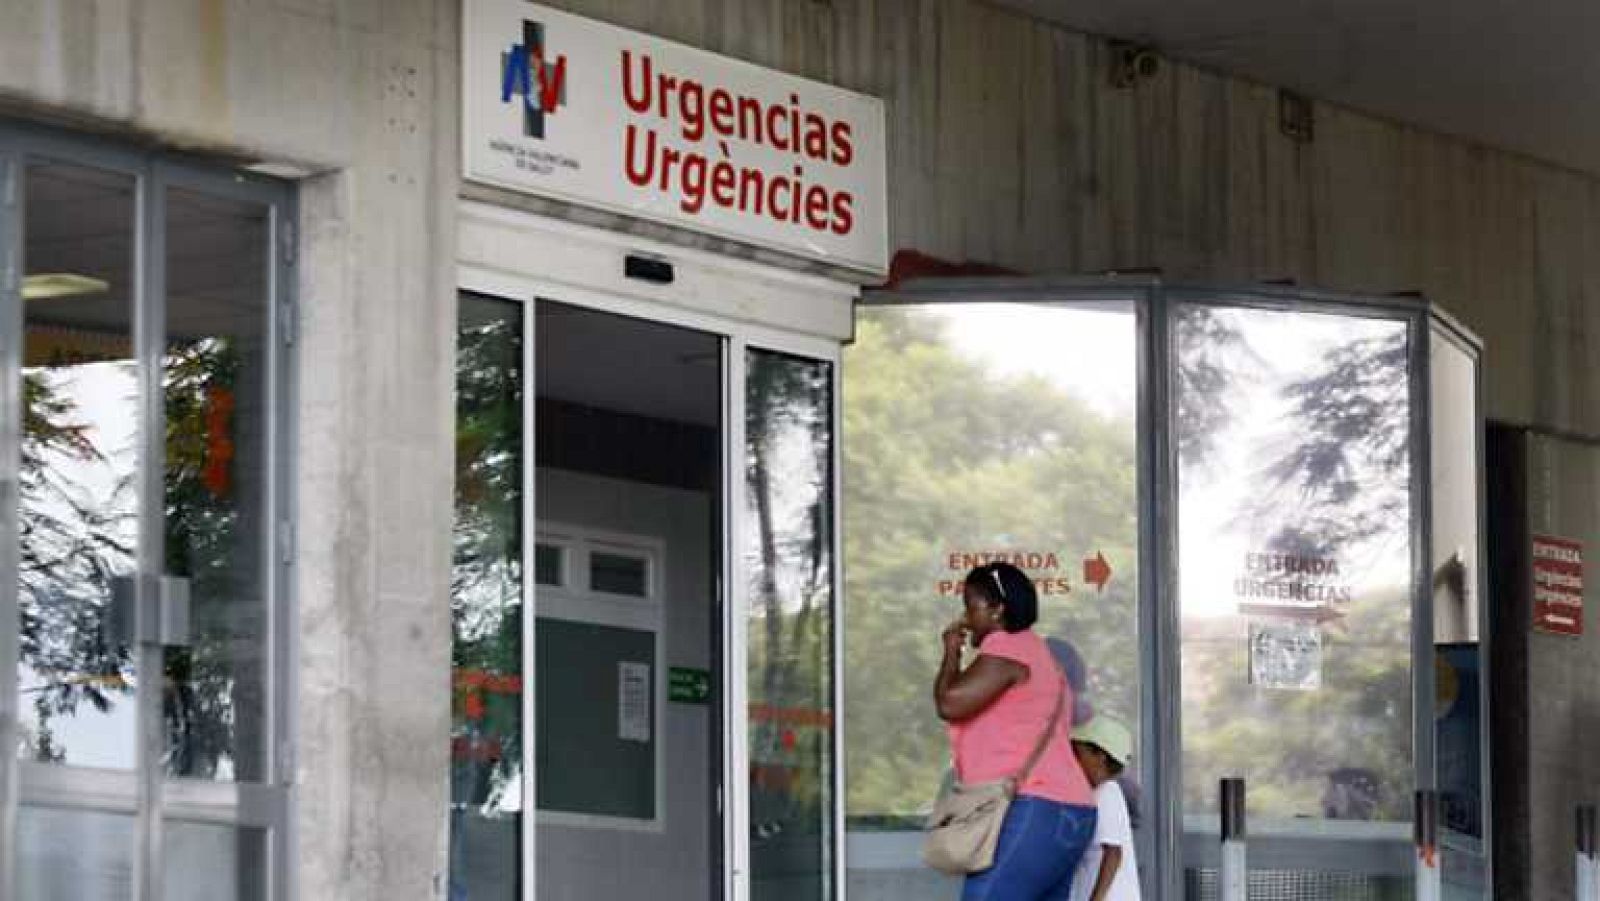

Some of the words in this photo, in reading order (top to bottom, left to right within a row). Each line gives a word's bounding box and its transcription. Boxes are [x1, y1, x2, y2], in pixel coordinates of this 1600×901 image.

[621, 50, 853, 166] Urgencias
[625, 124, 853, 235] Urgències
[949, 552, 1059, 570] ENTRADA
[1246, 552, 1340, 575] ENTRADA
[938, 578, 1071, 595] PATES
[1233, 578, 1351, 603] URGENCIAS
